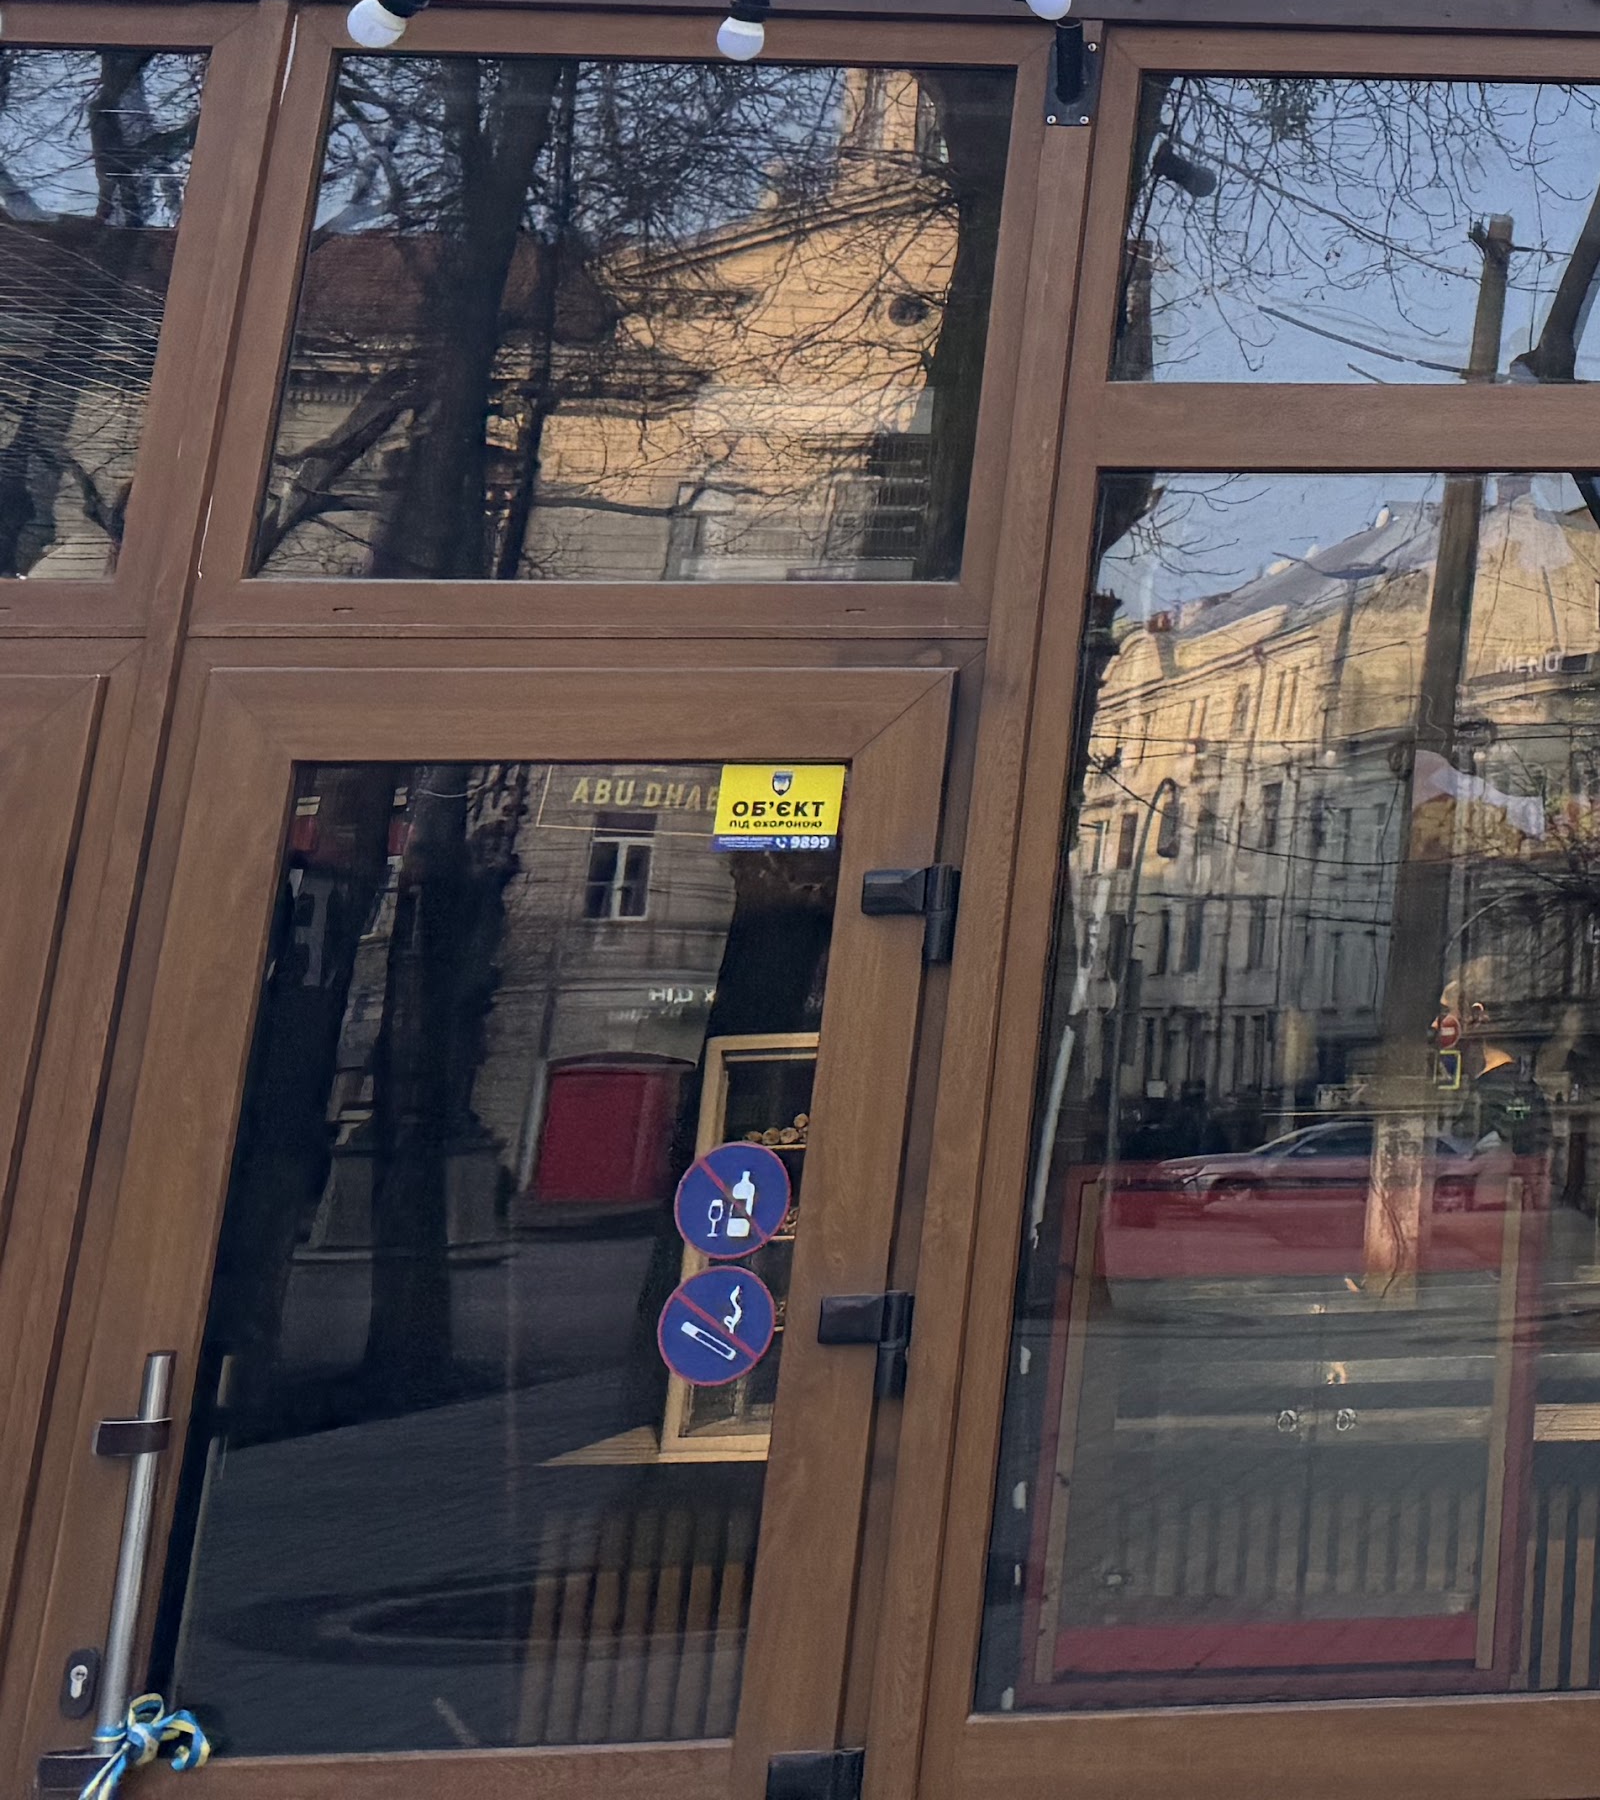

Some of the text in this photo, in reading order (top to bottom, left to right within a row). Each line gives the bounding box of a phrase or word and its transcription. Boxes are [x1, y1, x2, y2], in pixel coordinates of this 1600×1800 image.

[1494, 654, 1560, 674] MENU
[572, 777, 721, 812] ABU DHAB
[732, 801, 825, 817] ОБ'ЄКТ
[790, 836, 830, 849] 9899
